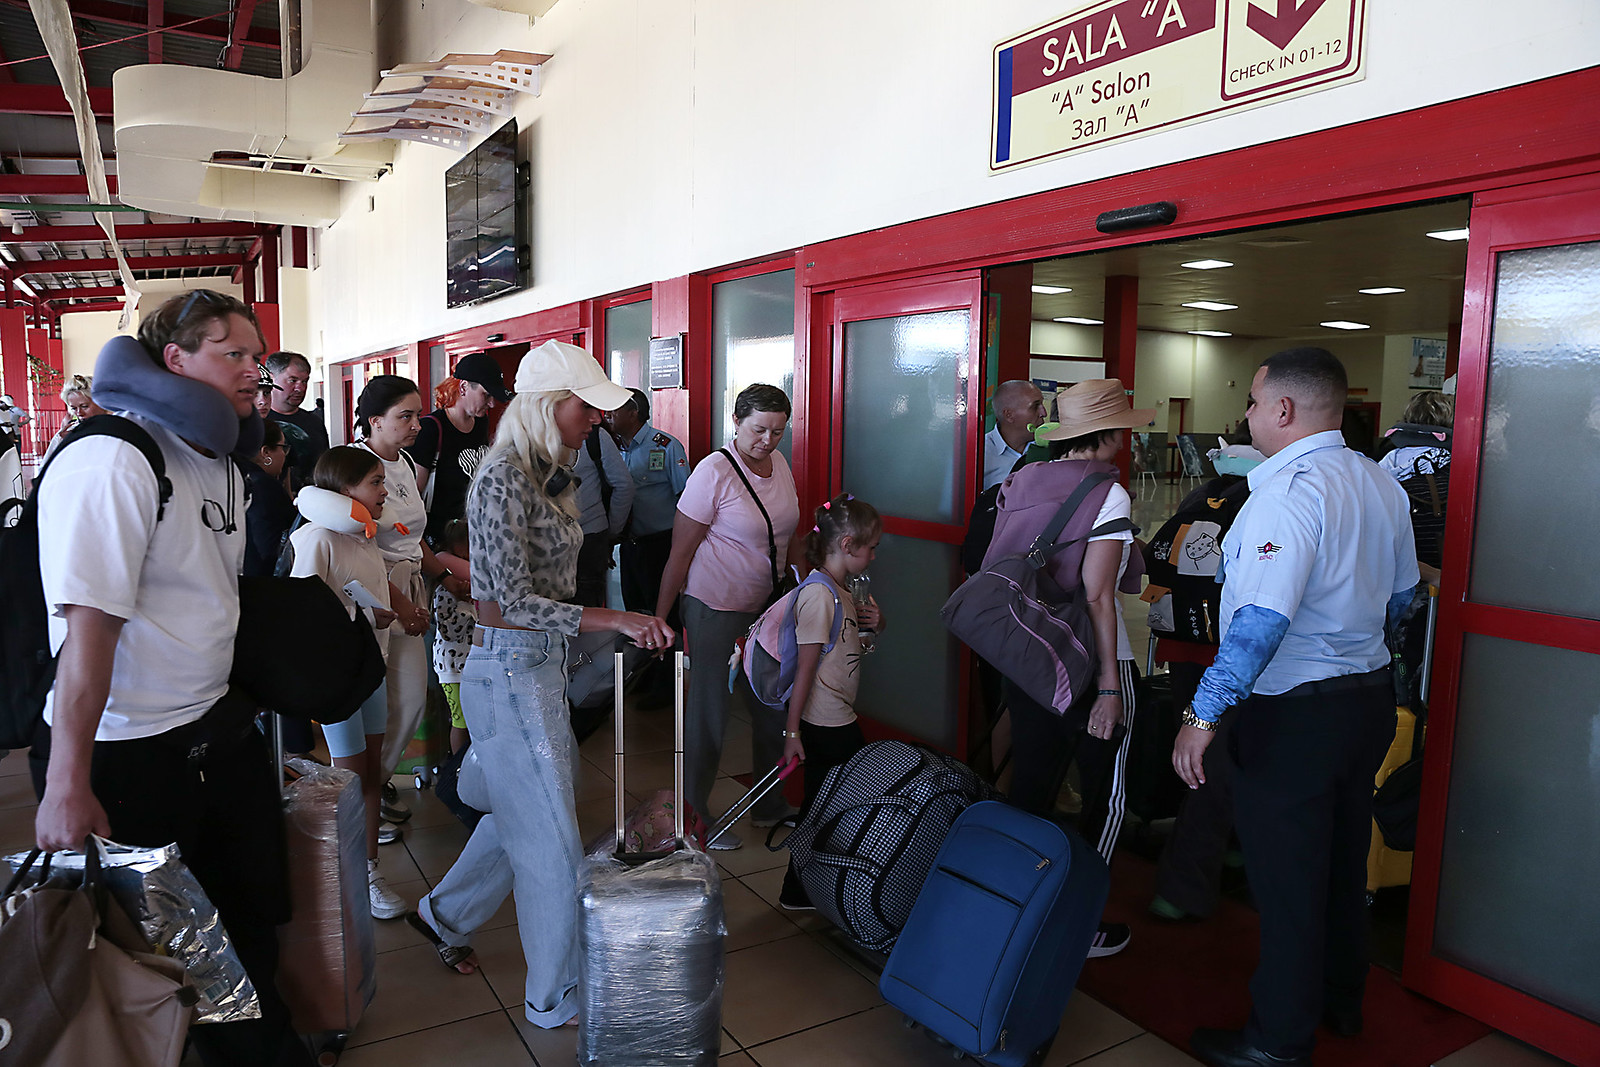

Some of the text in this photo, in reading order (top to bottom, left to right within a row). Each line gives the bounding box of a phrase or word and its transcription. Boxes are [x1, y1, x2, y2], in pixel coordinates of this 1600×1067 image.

[1042, 13, 1127, 77] SALA
[1229, 39, 1342, 83] CHECK IN 01-12
[1051, 71, 1150, 115] "A" Salon
[1071, 116, 1107, 140] Зал
